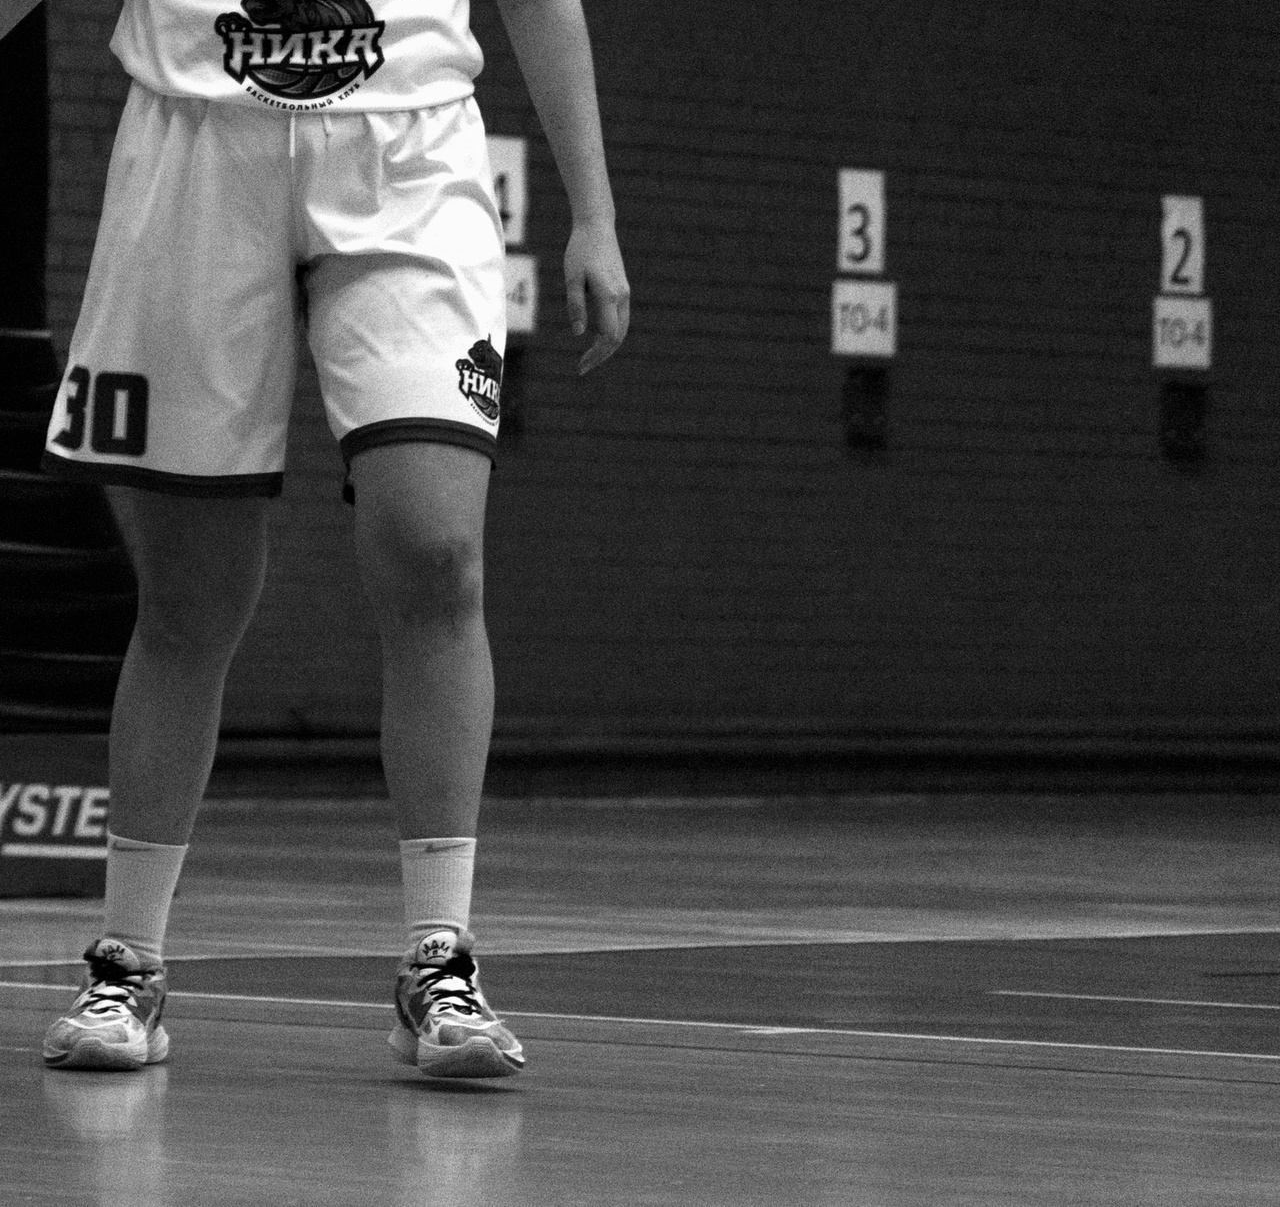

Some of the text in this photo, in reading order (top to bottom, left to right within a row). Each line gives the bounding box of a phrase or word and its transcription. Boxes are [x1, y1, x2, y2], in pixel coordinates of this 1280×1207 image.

[227, 26, 380, 76] НИКА
[245, 82, 361, 111] БАСКЕТБОЛЬНЫЙ КЛУБ
[846, 203, 872, 263] 3
[1170, 227, 1192, 284] 2
[52, 364, 150, 458] 30
